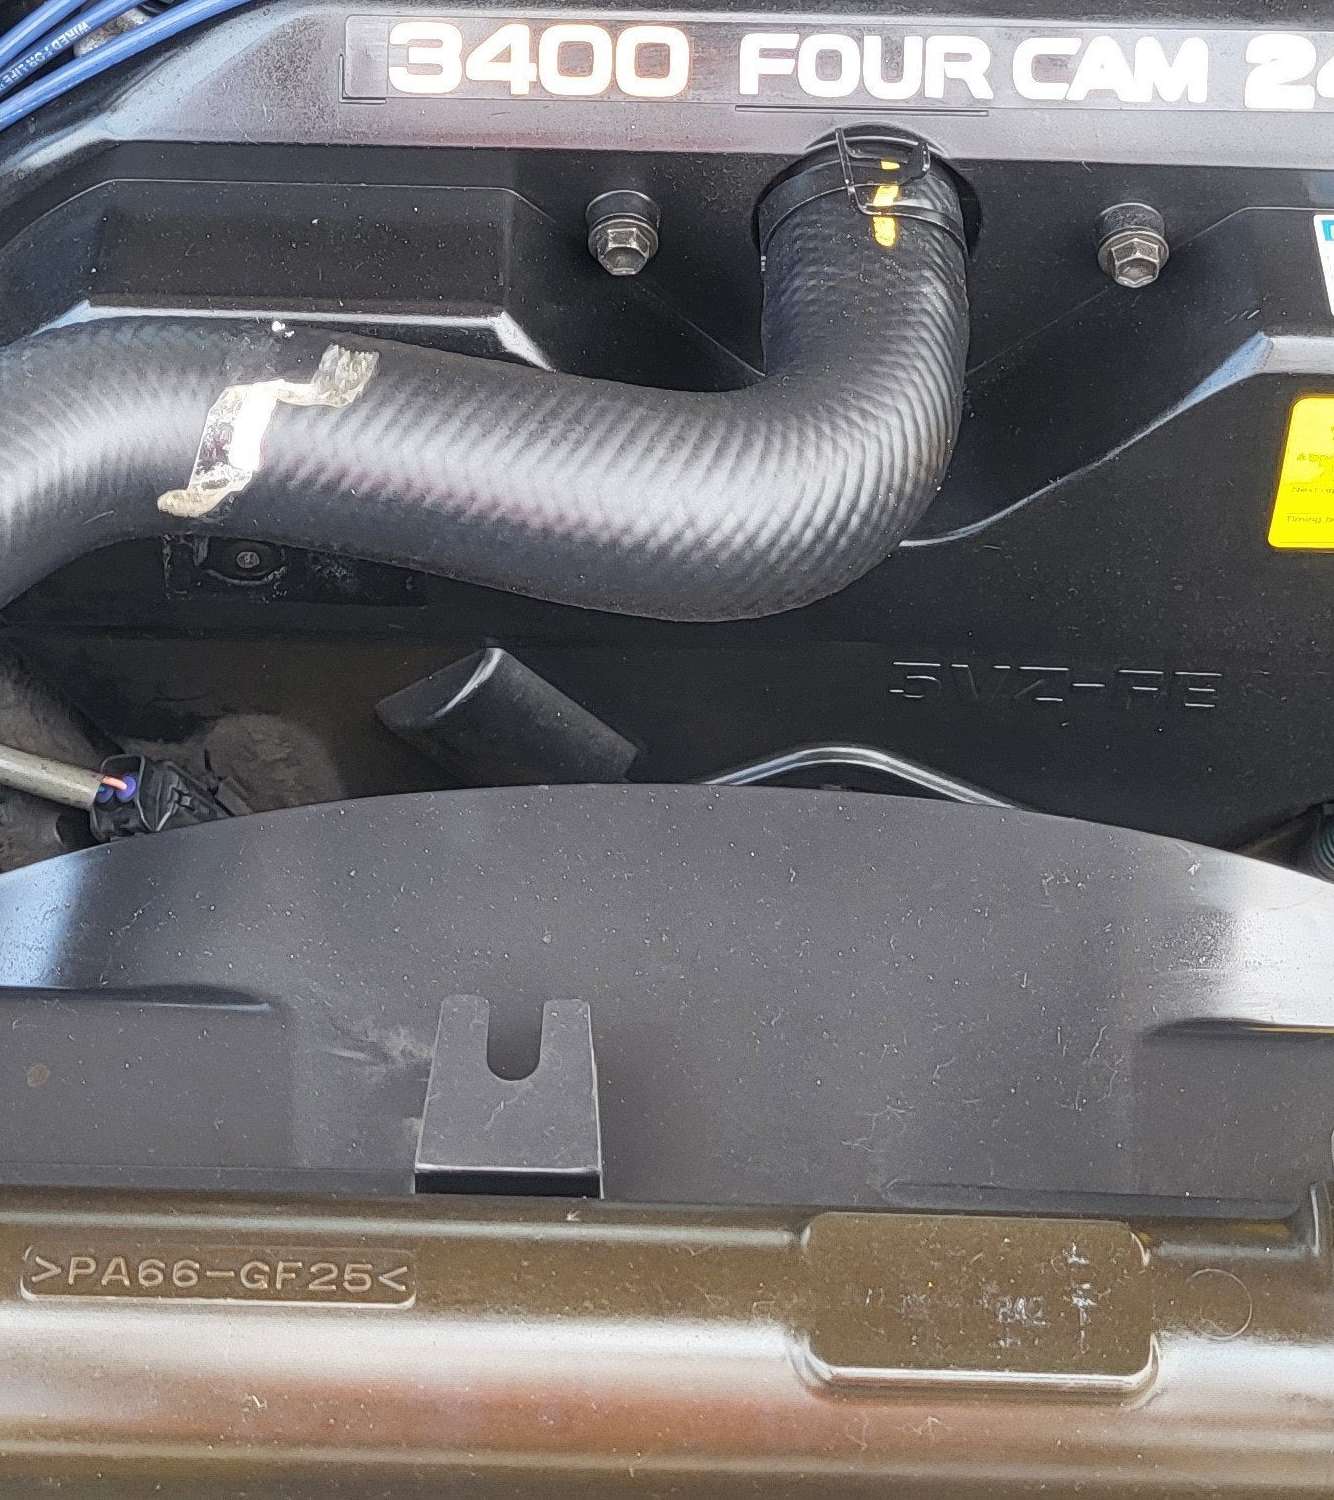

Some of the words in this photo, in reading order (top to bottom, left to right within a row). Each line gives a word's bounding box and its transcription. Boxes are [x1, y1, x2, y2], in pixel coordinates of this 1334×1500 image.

[51, 21, 90, 51] WIRED
[387, 19, 693, 101] 3400
[737, 31, 996, 105] FOUR
[1011, 33, 1210, 107] CAM
[30, 1255, 409, 1294] >PA66-GF25<
